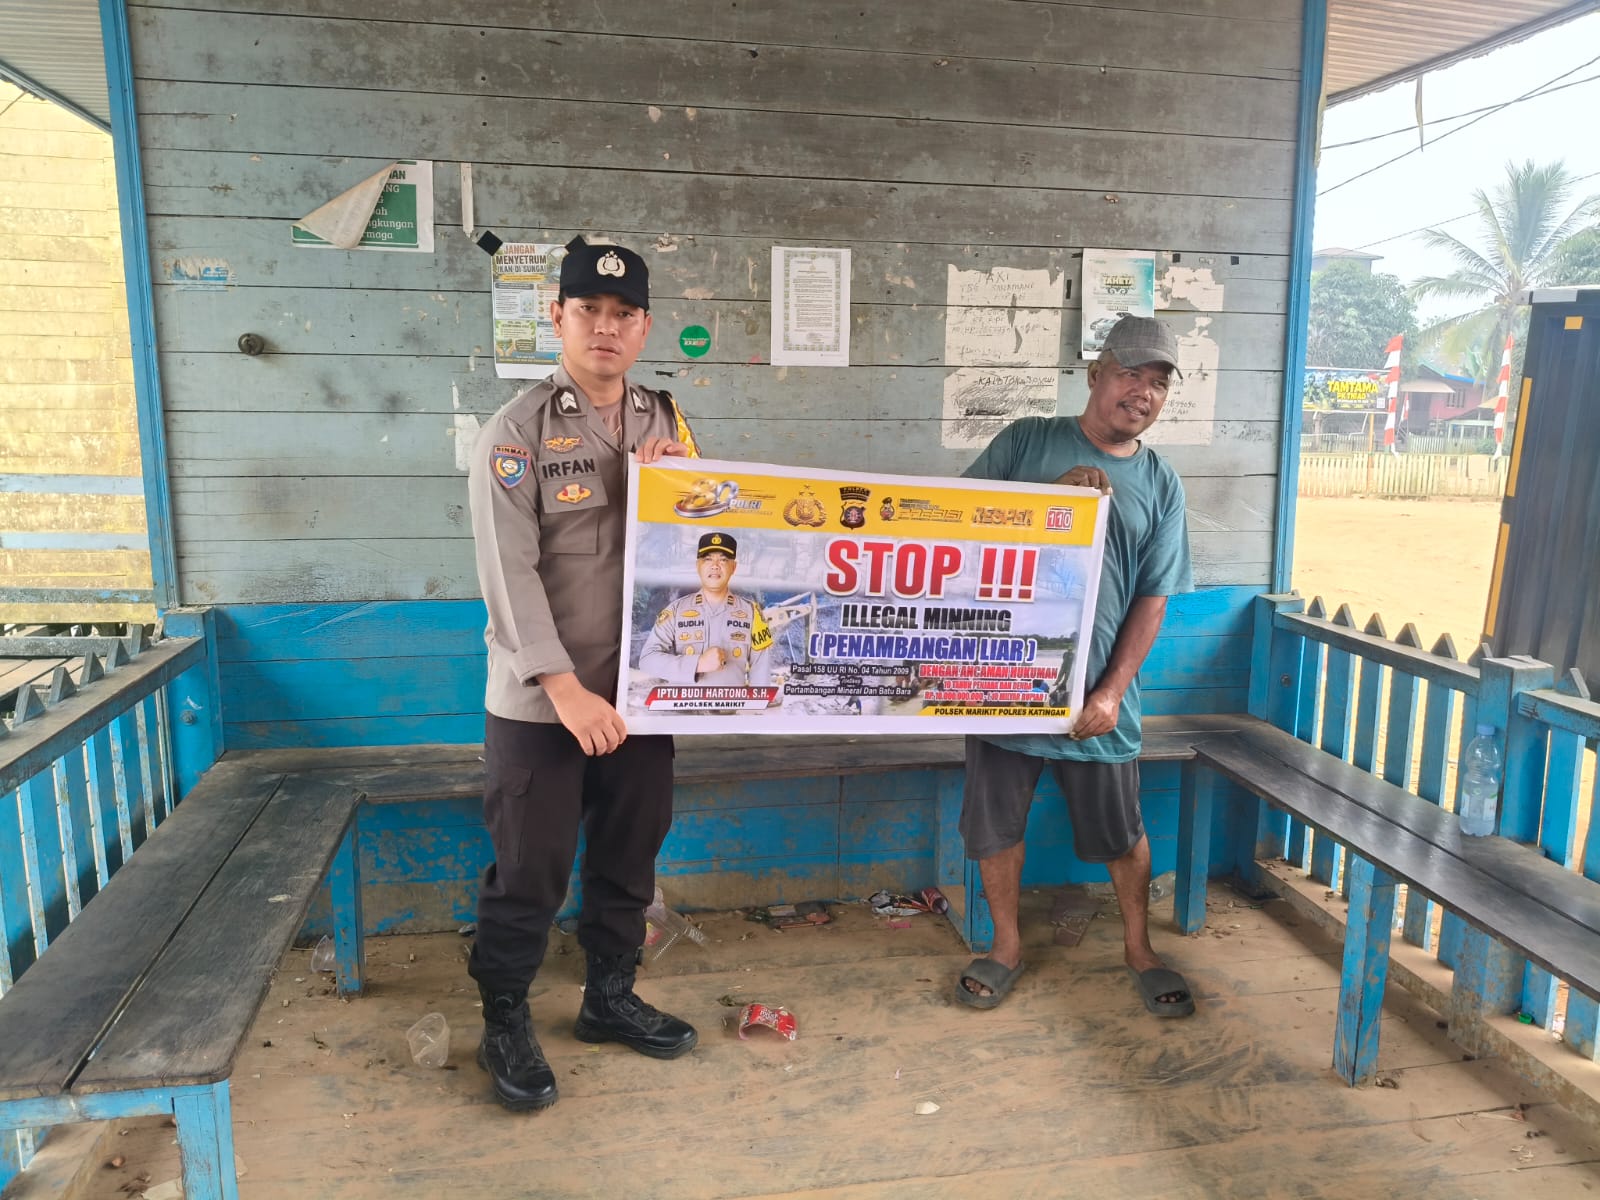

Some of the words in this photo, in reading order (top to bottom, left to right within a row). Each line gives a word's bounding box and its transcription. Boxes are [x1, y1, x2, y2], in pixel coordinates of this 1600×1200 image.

[504, 244, 536, 254] JANGAN
[496, 255, 547, 265] MENYETRUM
[1327, 381, 1379, 393] TAMTAMA
[542, 458, 596, 479] IRFAN
[1047, 511, 1072, 527] 110
[826, 539, 963, 597] STOP
[978, 547, 1037, 600] !!!
[841, 604, 918, 630] ILLEGAL
[922, 607, 1012, 632] MINNING
[823, 634, 976, 660] PENAMBANGAN
[980, 637, 1023, 662] LIAR
[792, 665, 812, 673] Pasal
[813, 665, 826, 673] 158
[839, 666, 847, 674] RI
[893, 667, 910, 675] 2009
[919, 665, 958, 677] DENGAN
[959, 666, 1009, 678] ANCAMAN
[1011, 667, 1058, 679] HUKUMAN
[657, 688, 678, 699] IPTU
[681, 688, 703, 699] BUDI
[752, 688, 770, 699] S.H.
[785, 687, 836, 696] Pertambangan
[836, 687, 862, 695] Mineral
